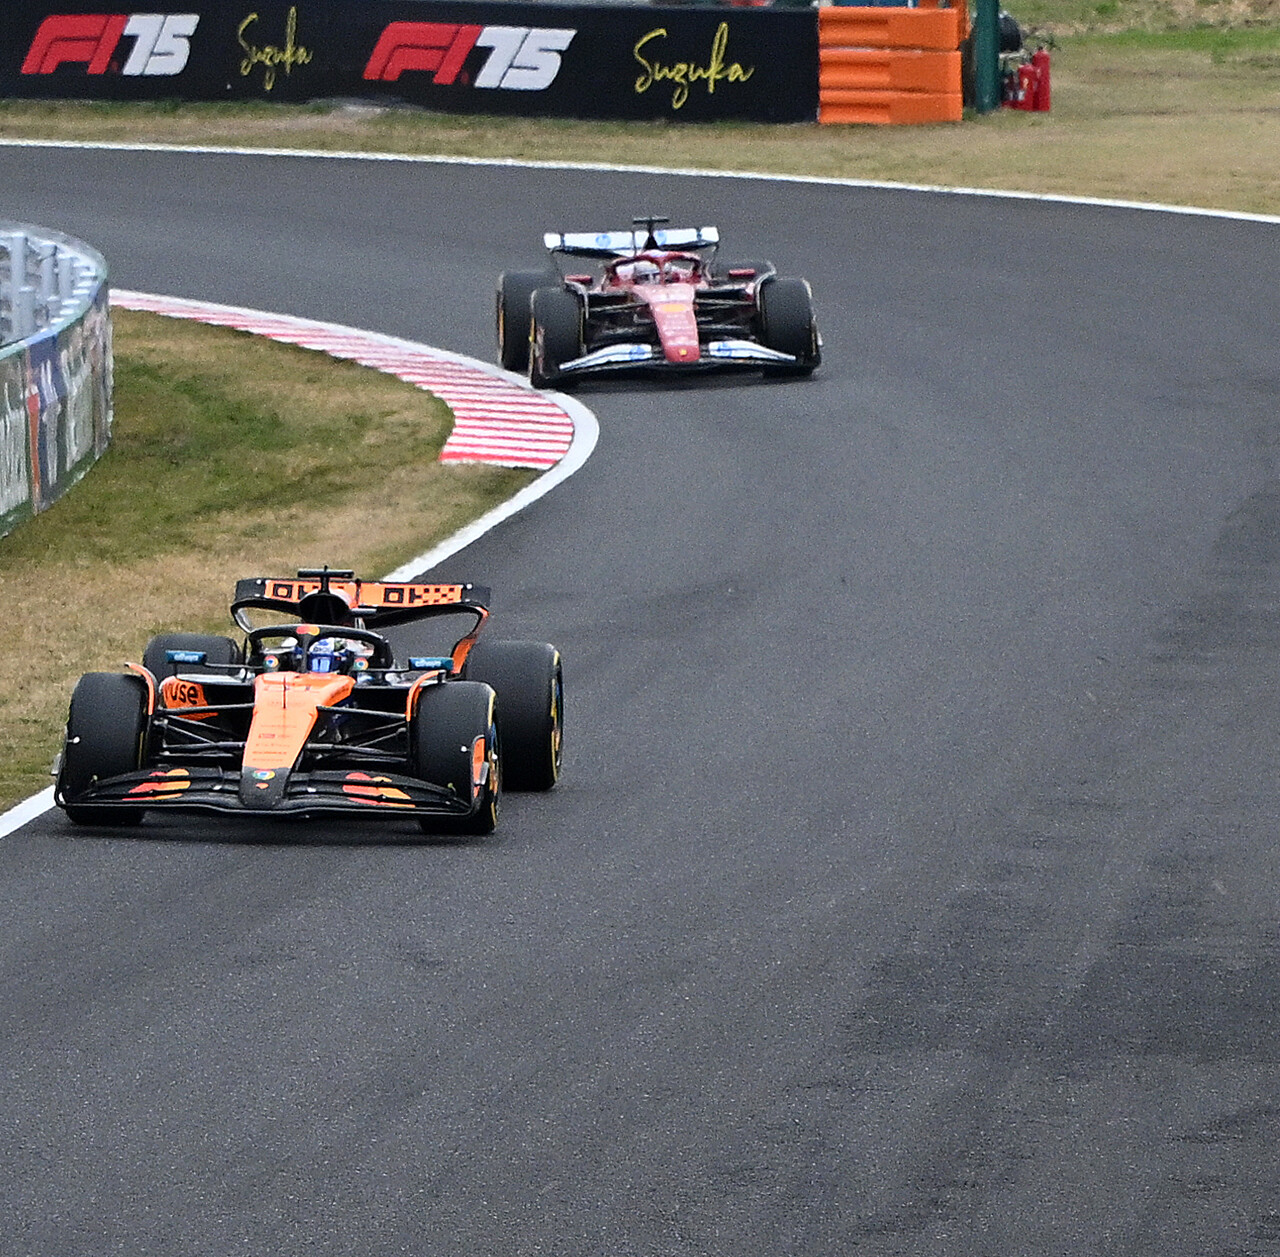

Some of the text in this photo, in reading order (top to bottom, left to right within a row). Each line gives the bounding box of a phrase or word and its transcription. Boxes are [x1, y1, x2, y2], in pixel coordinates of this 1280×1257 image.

[122, 13, 200, 76] 75
[238, 6, 313, 90] Suzuka
[474, 25, 578, 91] 75
[634, 22, 754, 109] Suzuka
